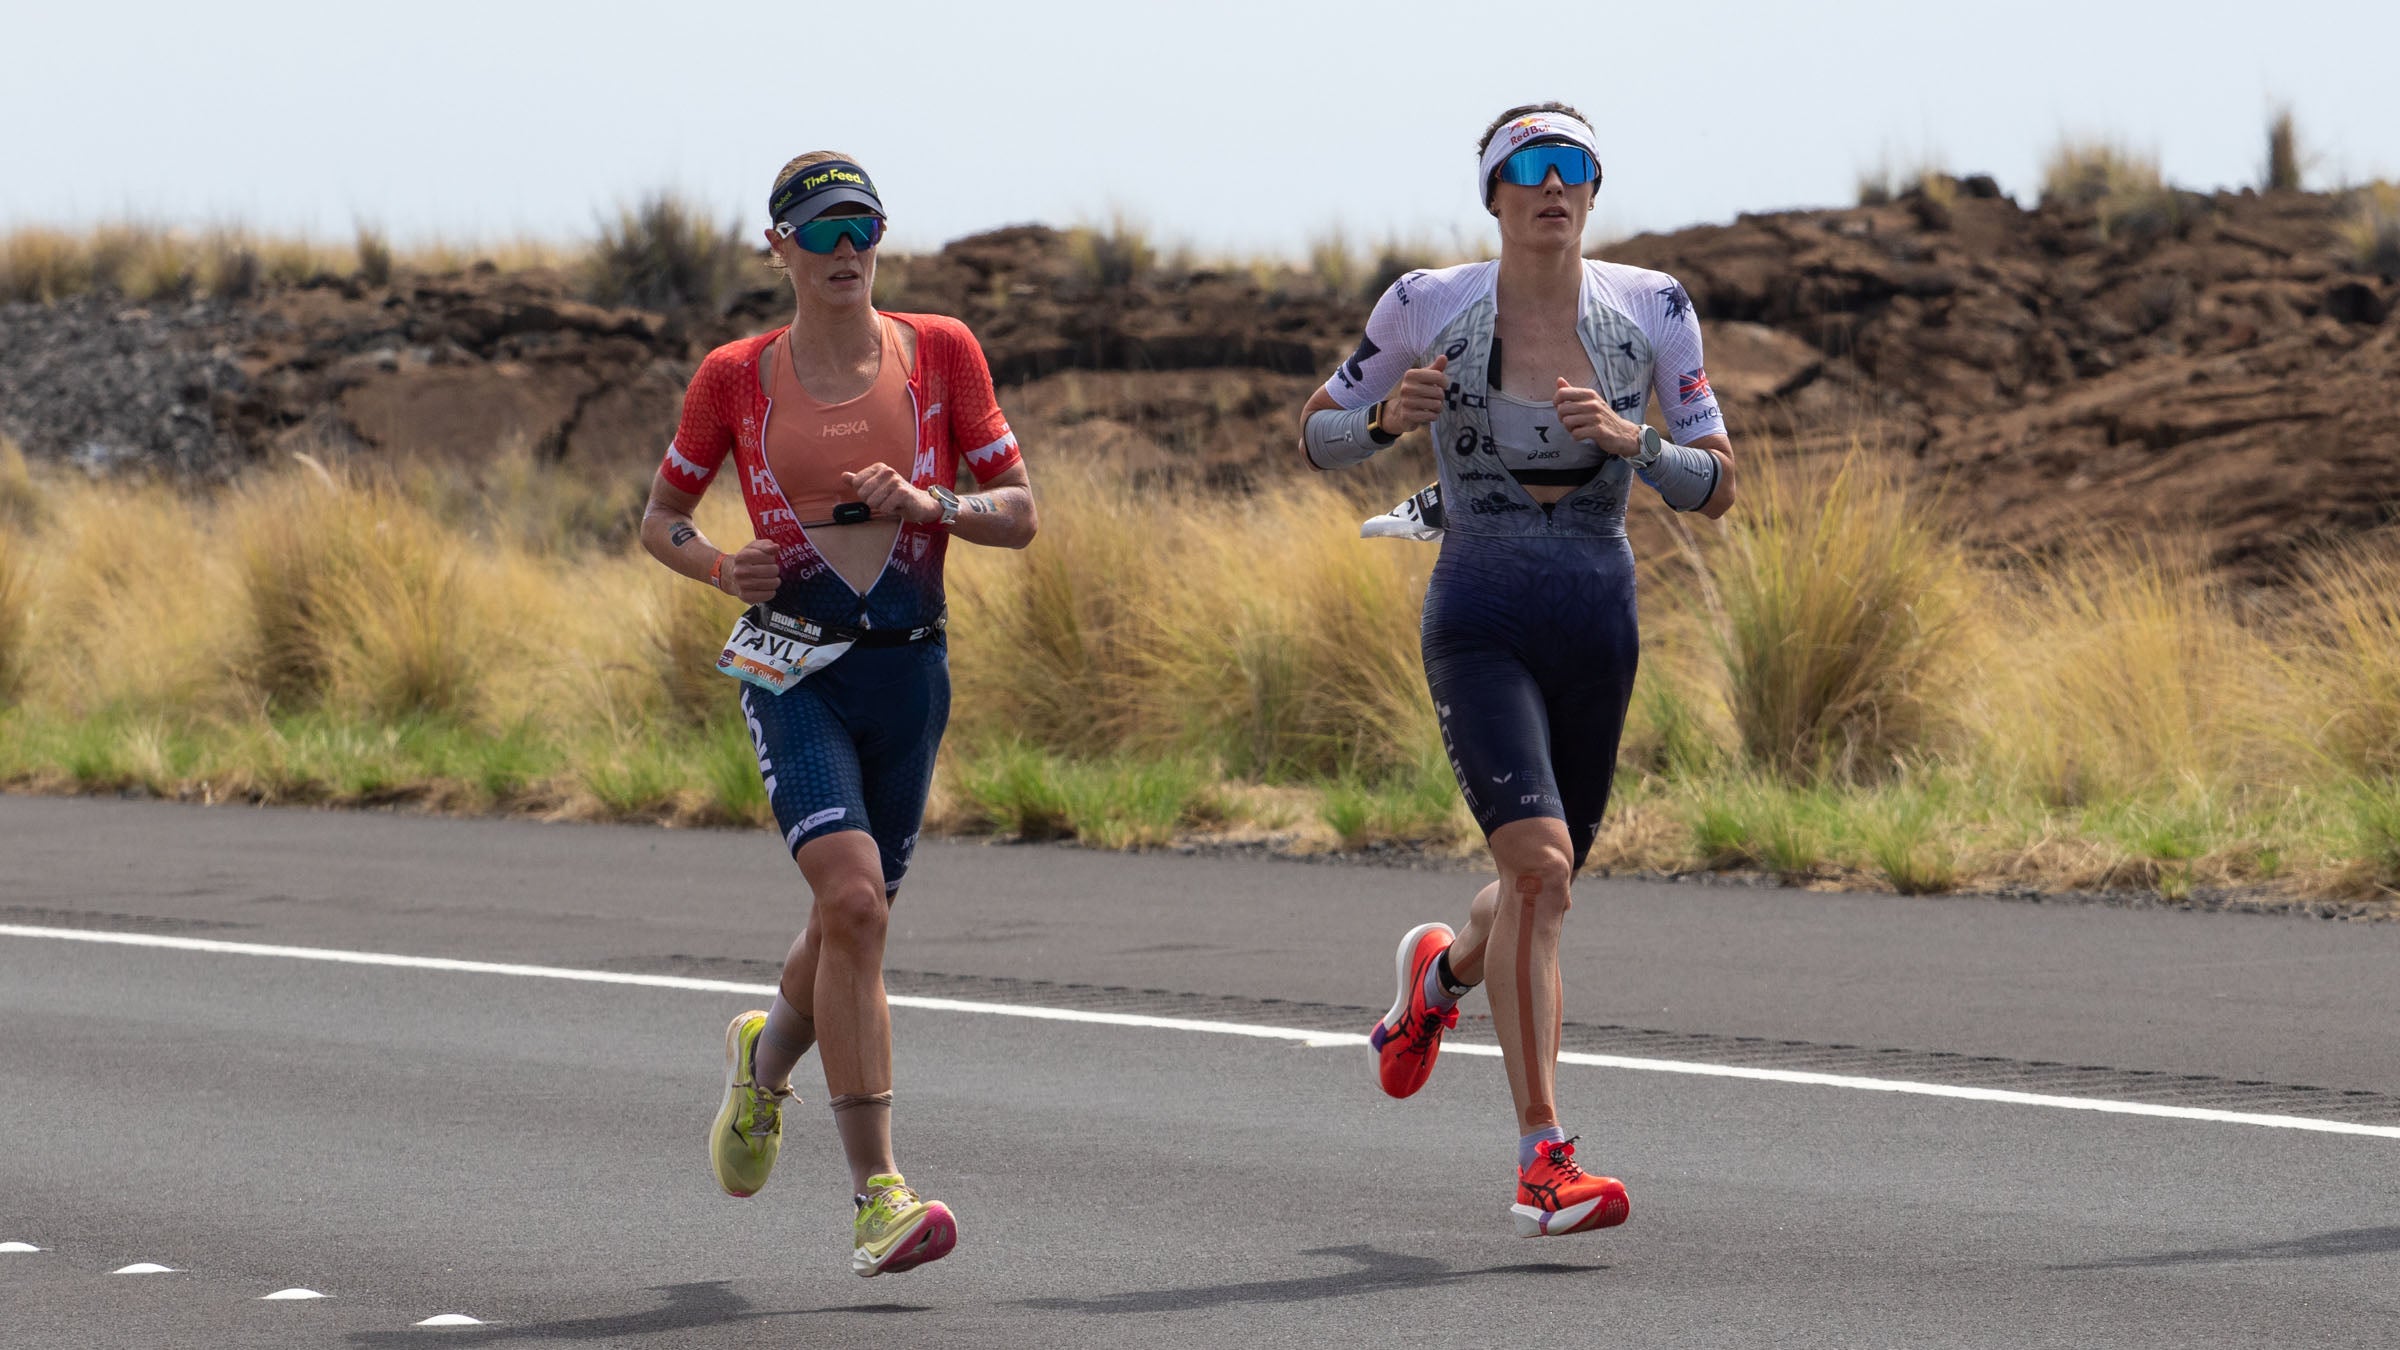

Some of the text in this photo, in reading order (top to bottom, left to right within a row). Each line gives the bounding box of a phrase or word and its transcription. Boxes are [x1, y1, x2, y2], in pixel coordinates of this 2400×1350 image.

[1510, 128, 1530, 146] Red
[803, 168, 864, 190] The Feed.
[822, 419, 870, 438] HOKA
[671, 527, 697, 547] 6
[1520, 794, 1541, 805] DT
